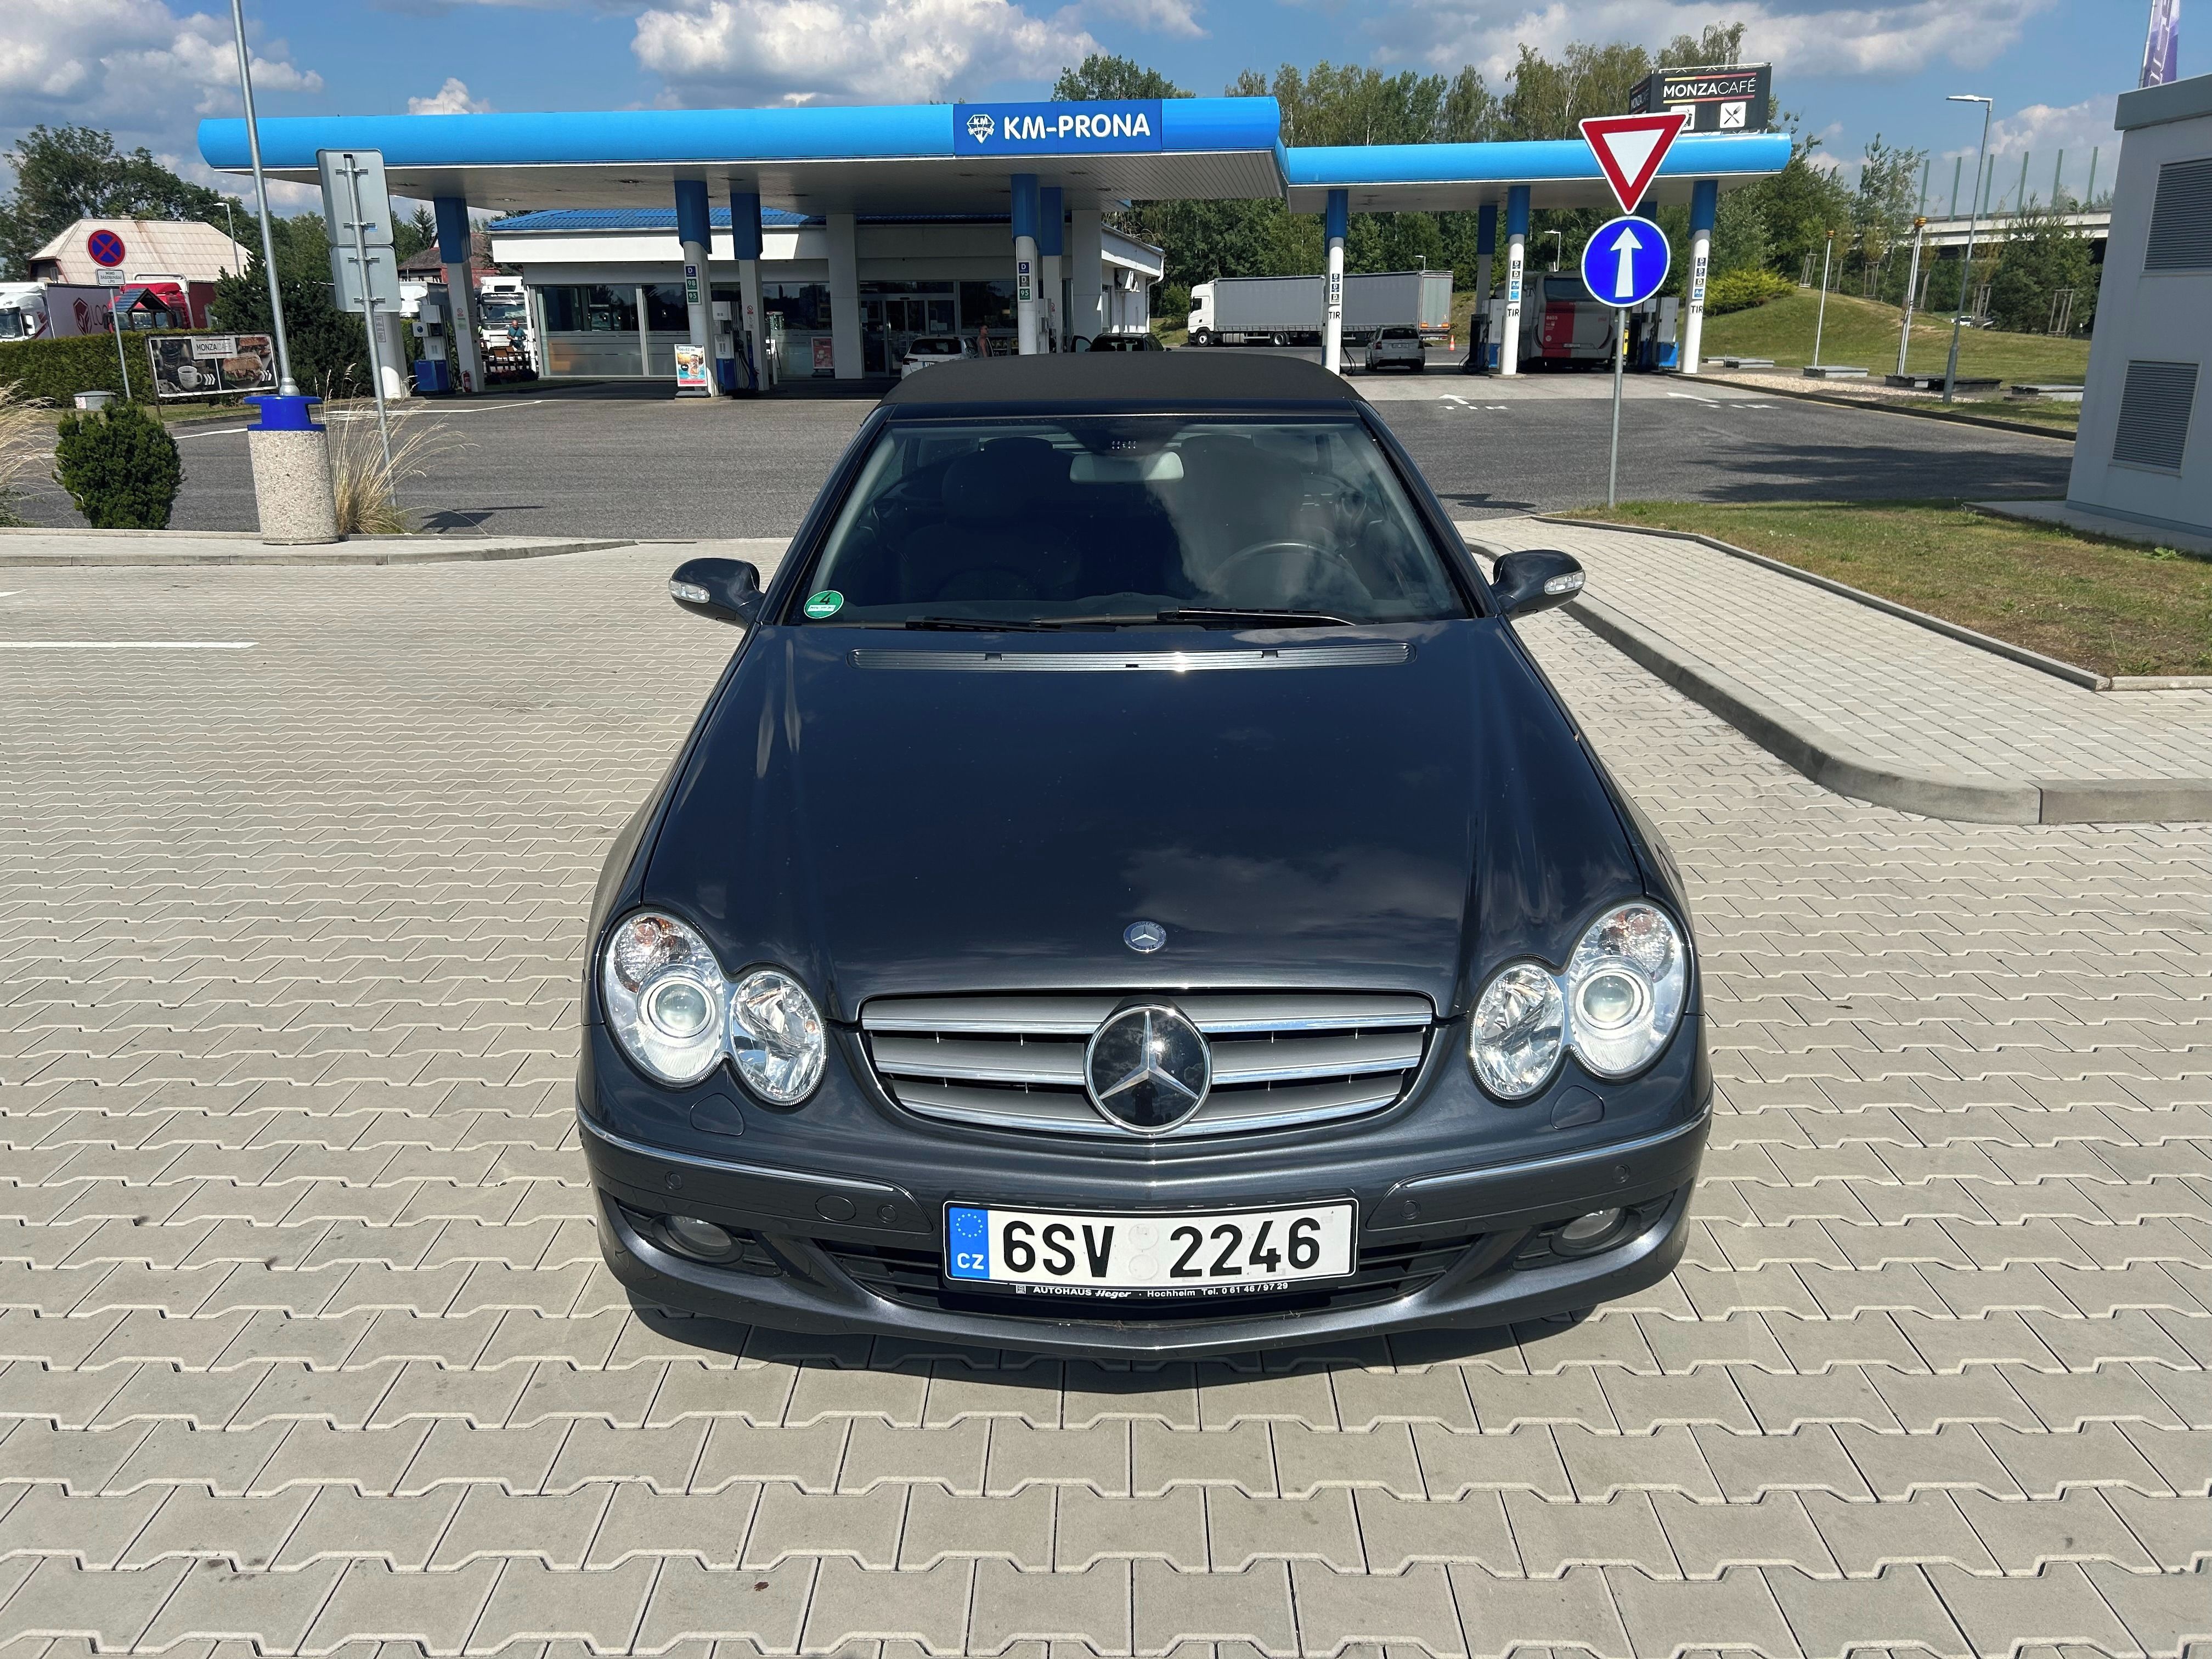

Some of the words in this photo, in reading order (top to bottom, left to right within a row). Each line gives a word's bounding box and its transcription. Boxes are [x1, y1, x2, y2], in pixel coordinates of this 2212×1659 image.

[1663, 77, 1756, 98] MONZACAFÉ
[1005, 113, 1150, 139] KM-PRONA
[1328, 311, 1340, 319] TIR
[1507, 308, 1519, 317] TIR
[1691, 306, 1703, 314] TIR
[819, 592, 832, 605] 4
[1003, 1220, 1115, 1278] 6SV
[1170, 1217, 1321, 1278] 2246
[957, 1252, 985, 1270] CZ
[1033, 1286, 1092, 1296] AUTOHAUS
[1094, 1289, 1132, 1299] Heger
[1147, 1289, 1195, 1297] Hochheim
